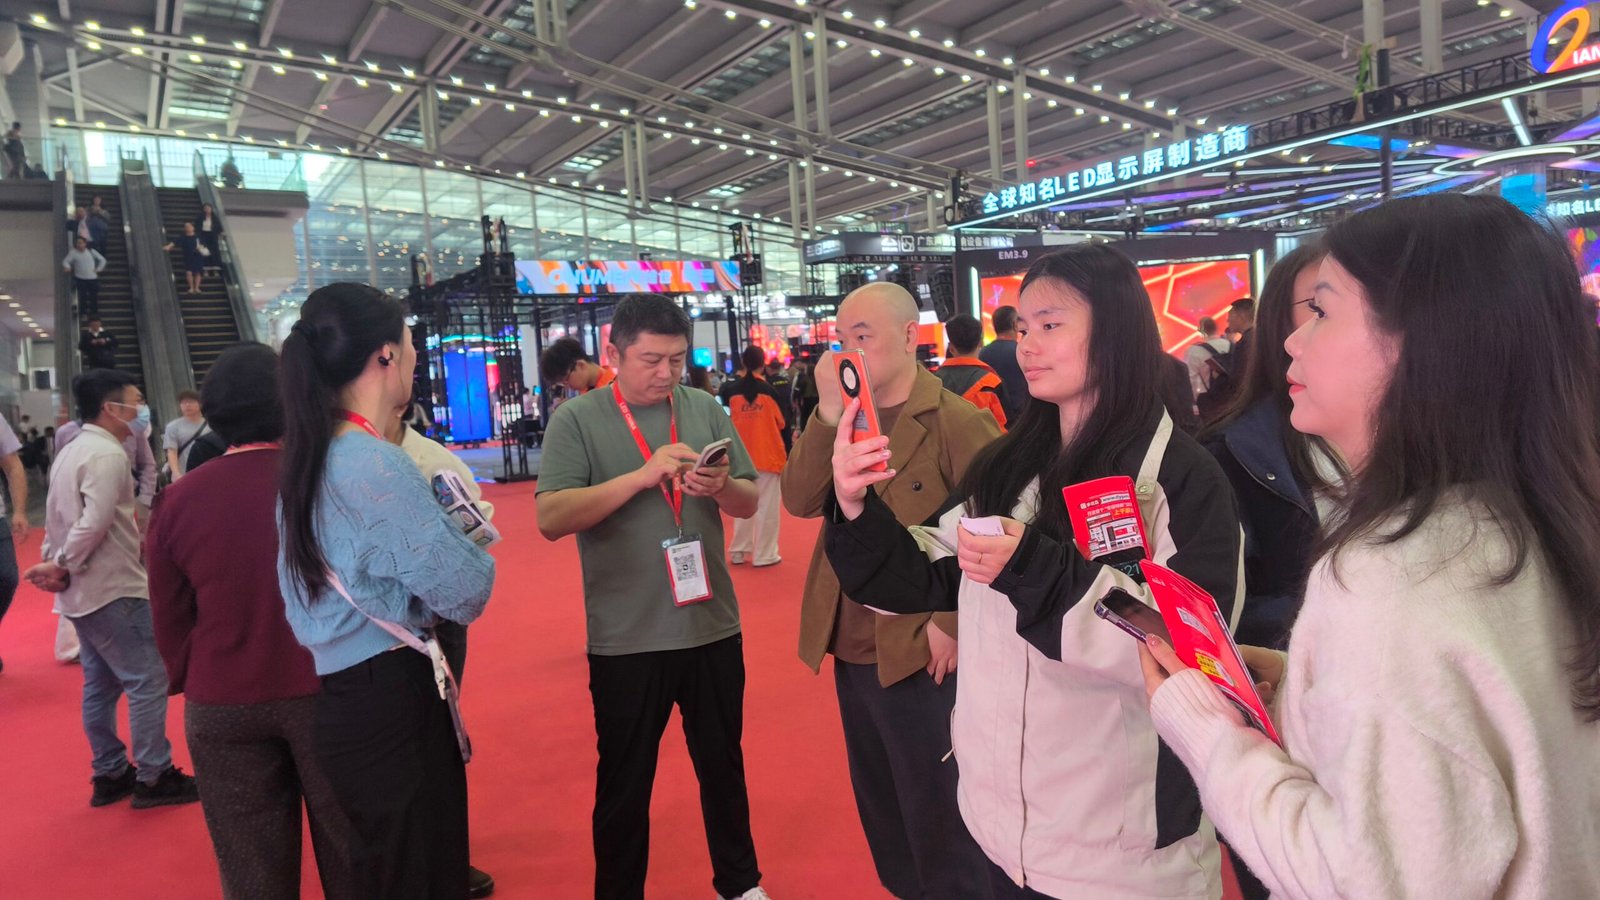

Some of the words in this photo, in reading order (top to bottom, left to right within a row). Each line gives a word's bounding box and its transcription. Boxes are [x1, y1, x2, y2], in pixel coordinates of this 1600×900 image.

[983, 126, 1250, 214] 全球知名LED显示屏制造商
[998, 250, 1029, 261] EM3.9
